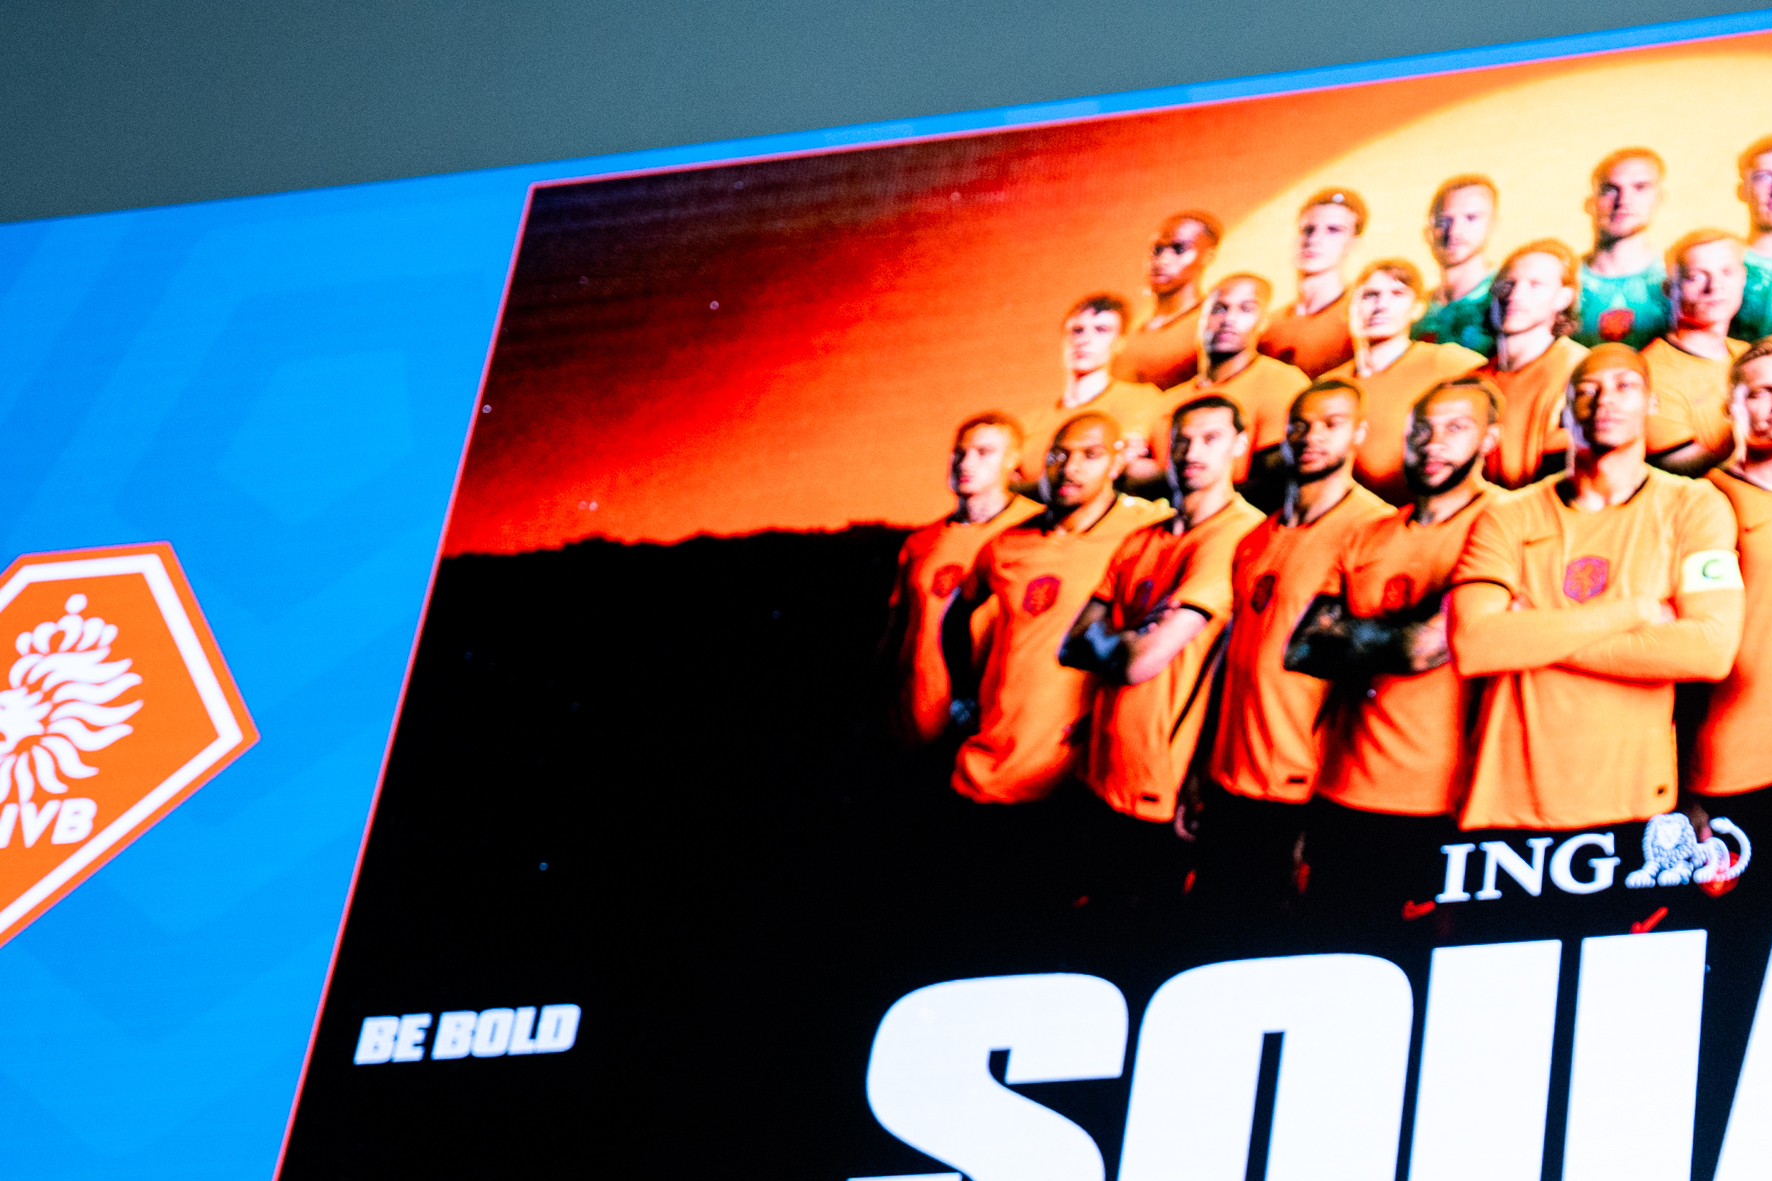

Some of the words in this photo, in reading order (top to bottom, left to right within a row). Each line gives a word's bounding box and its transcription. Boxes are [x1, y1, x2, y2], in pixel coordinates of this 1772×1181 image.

[1435, 831, 1621, 903] ING
[353, 1012, 433, 1065] BE
[431, 1003, 582, 1060] BOLD
